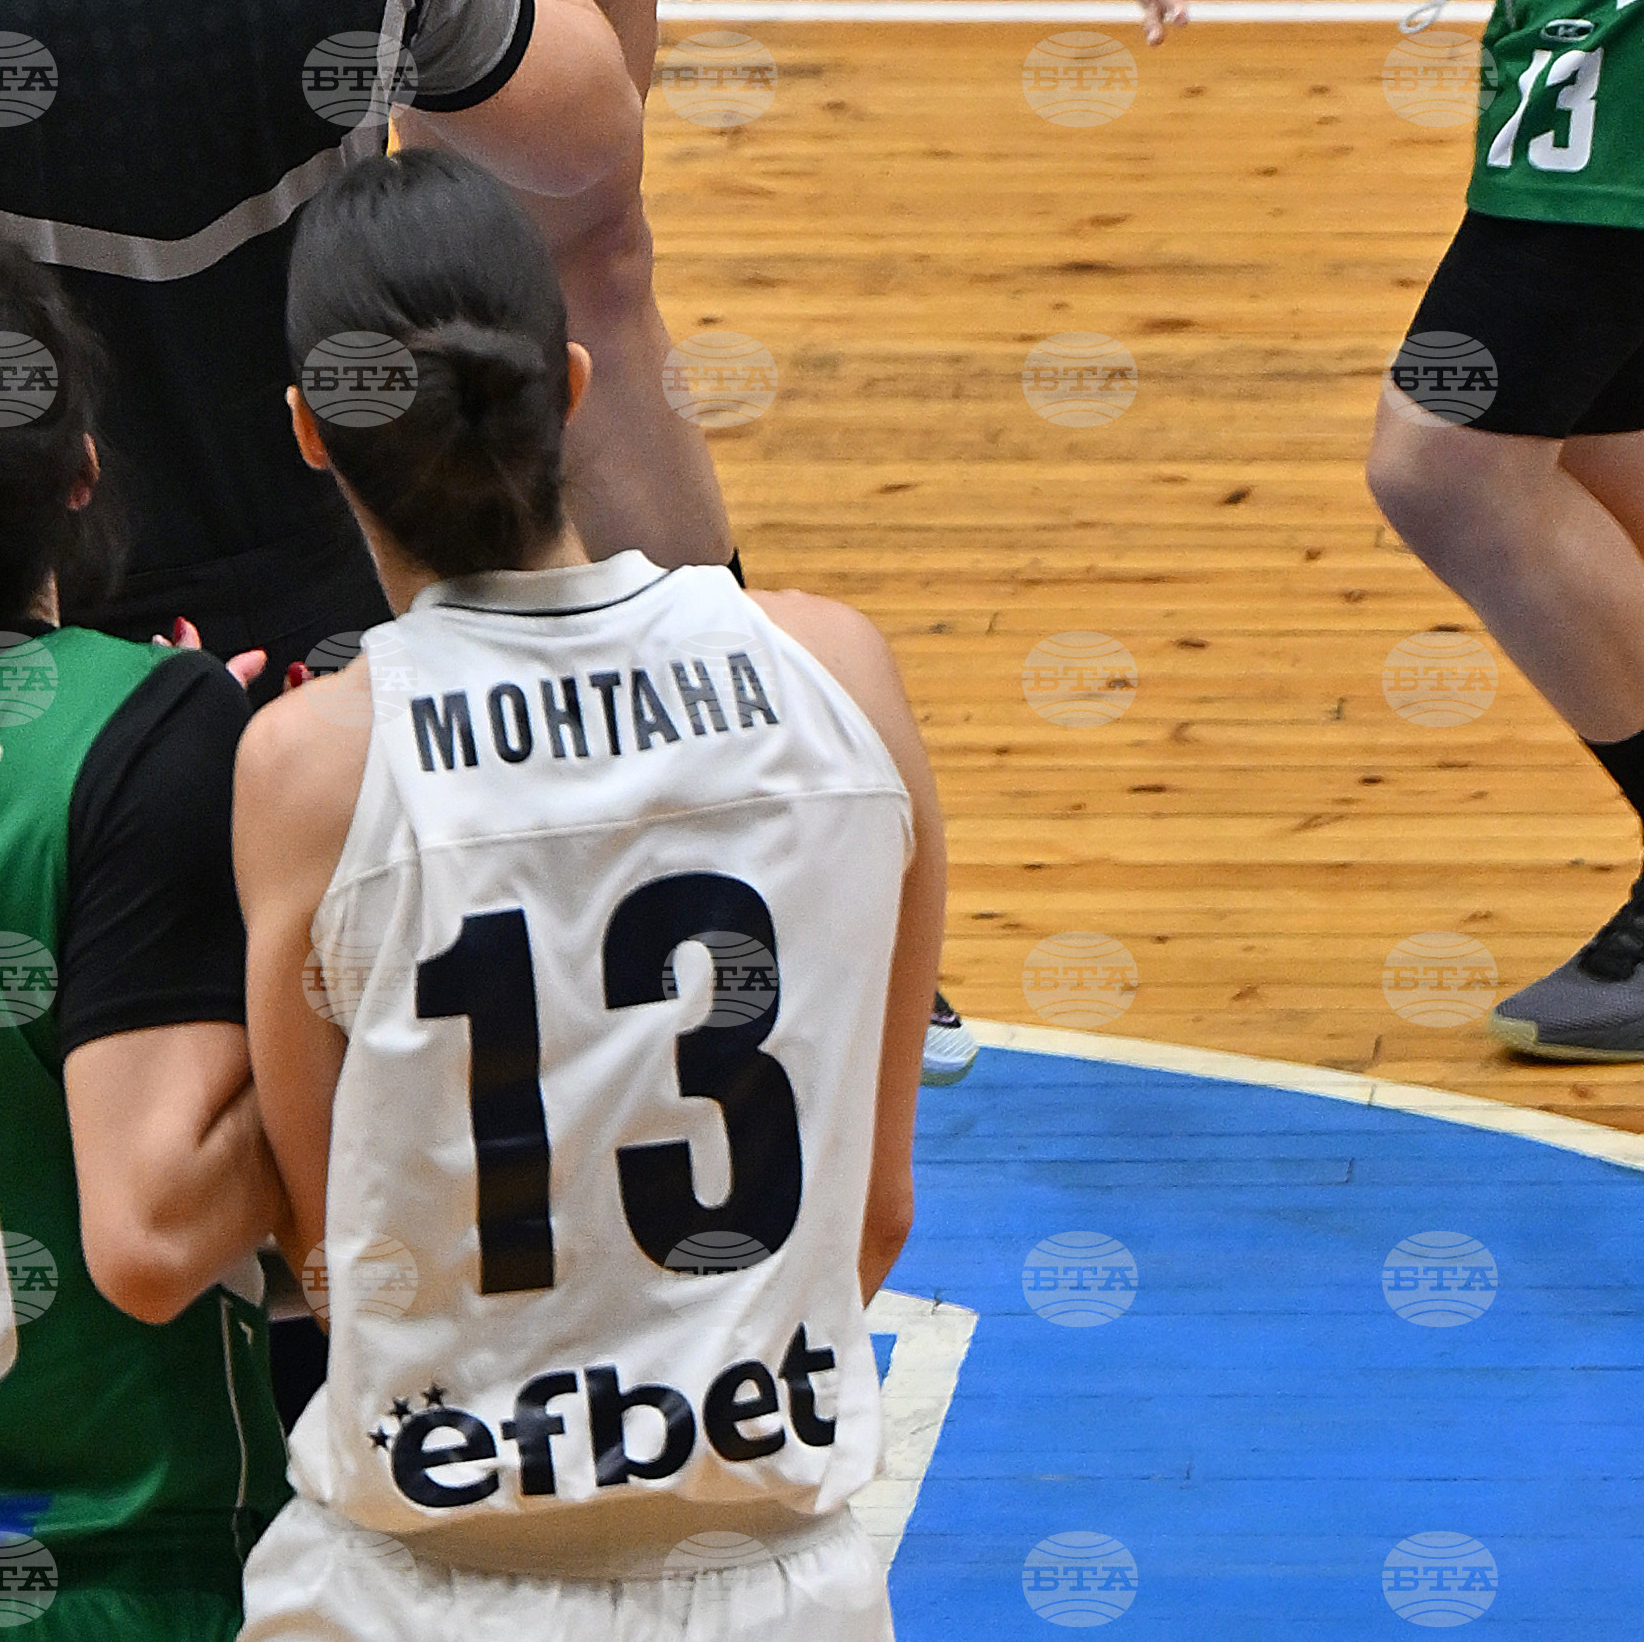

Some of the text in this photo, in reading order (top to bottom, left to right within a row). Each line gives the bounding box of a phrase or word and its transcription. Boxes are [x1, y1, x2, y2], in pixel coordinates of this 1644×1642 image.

[1486, 47, 1604, 173] 13
[410, 652, 780, 773] МОНТАНА
[416, 870, 804, 1296] 13
[389, 1321, 836, 1508] efbet
